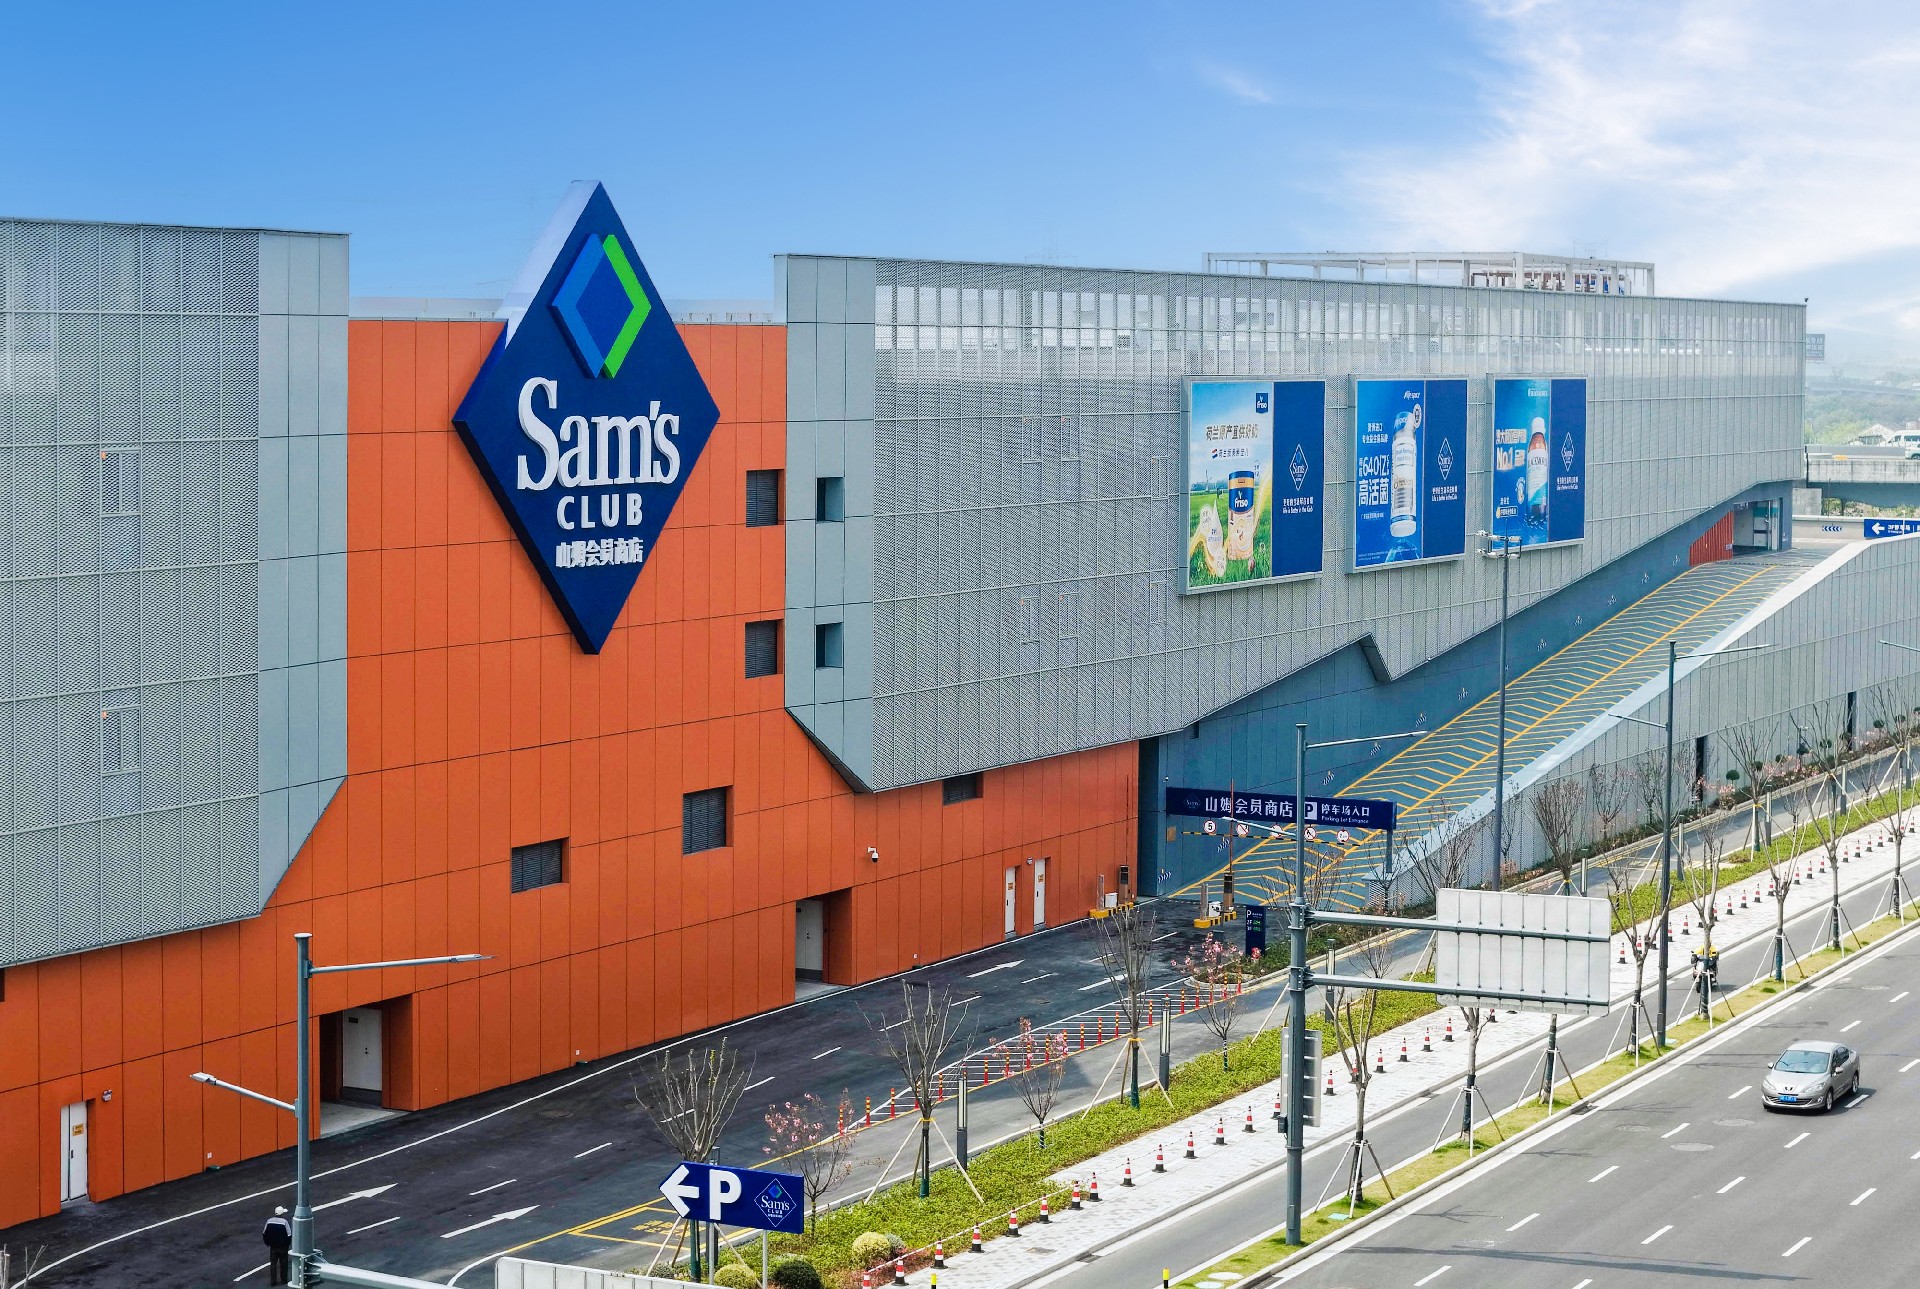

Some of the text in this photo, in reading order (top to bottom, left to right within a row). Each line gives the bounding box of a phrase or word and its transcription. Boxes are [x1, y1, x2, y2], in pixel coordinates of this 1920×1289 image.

[516, 376, 680, 491] Sam's
[1358, 478, 1390, 506] 高活菌
[556, 493, 643, 530] CLUB
[1234, 498, 1249, 508] friso
[555, 537, 643, 568] 山姆会员商店
[1205, 796, 1294, 818] 山姆会员商店
[1321, 803, 1370, 817] 停车场入口
[1208, 823, 1213, 831] 5
[1321, 815, 1339, 823] Parking
[1246, 909, 1252, 918] P
[709, 1169, 742, 1221] P
[761, 1195, 790, 1211] Sam's
